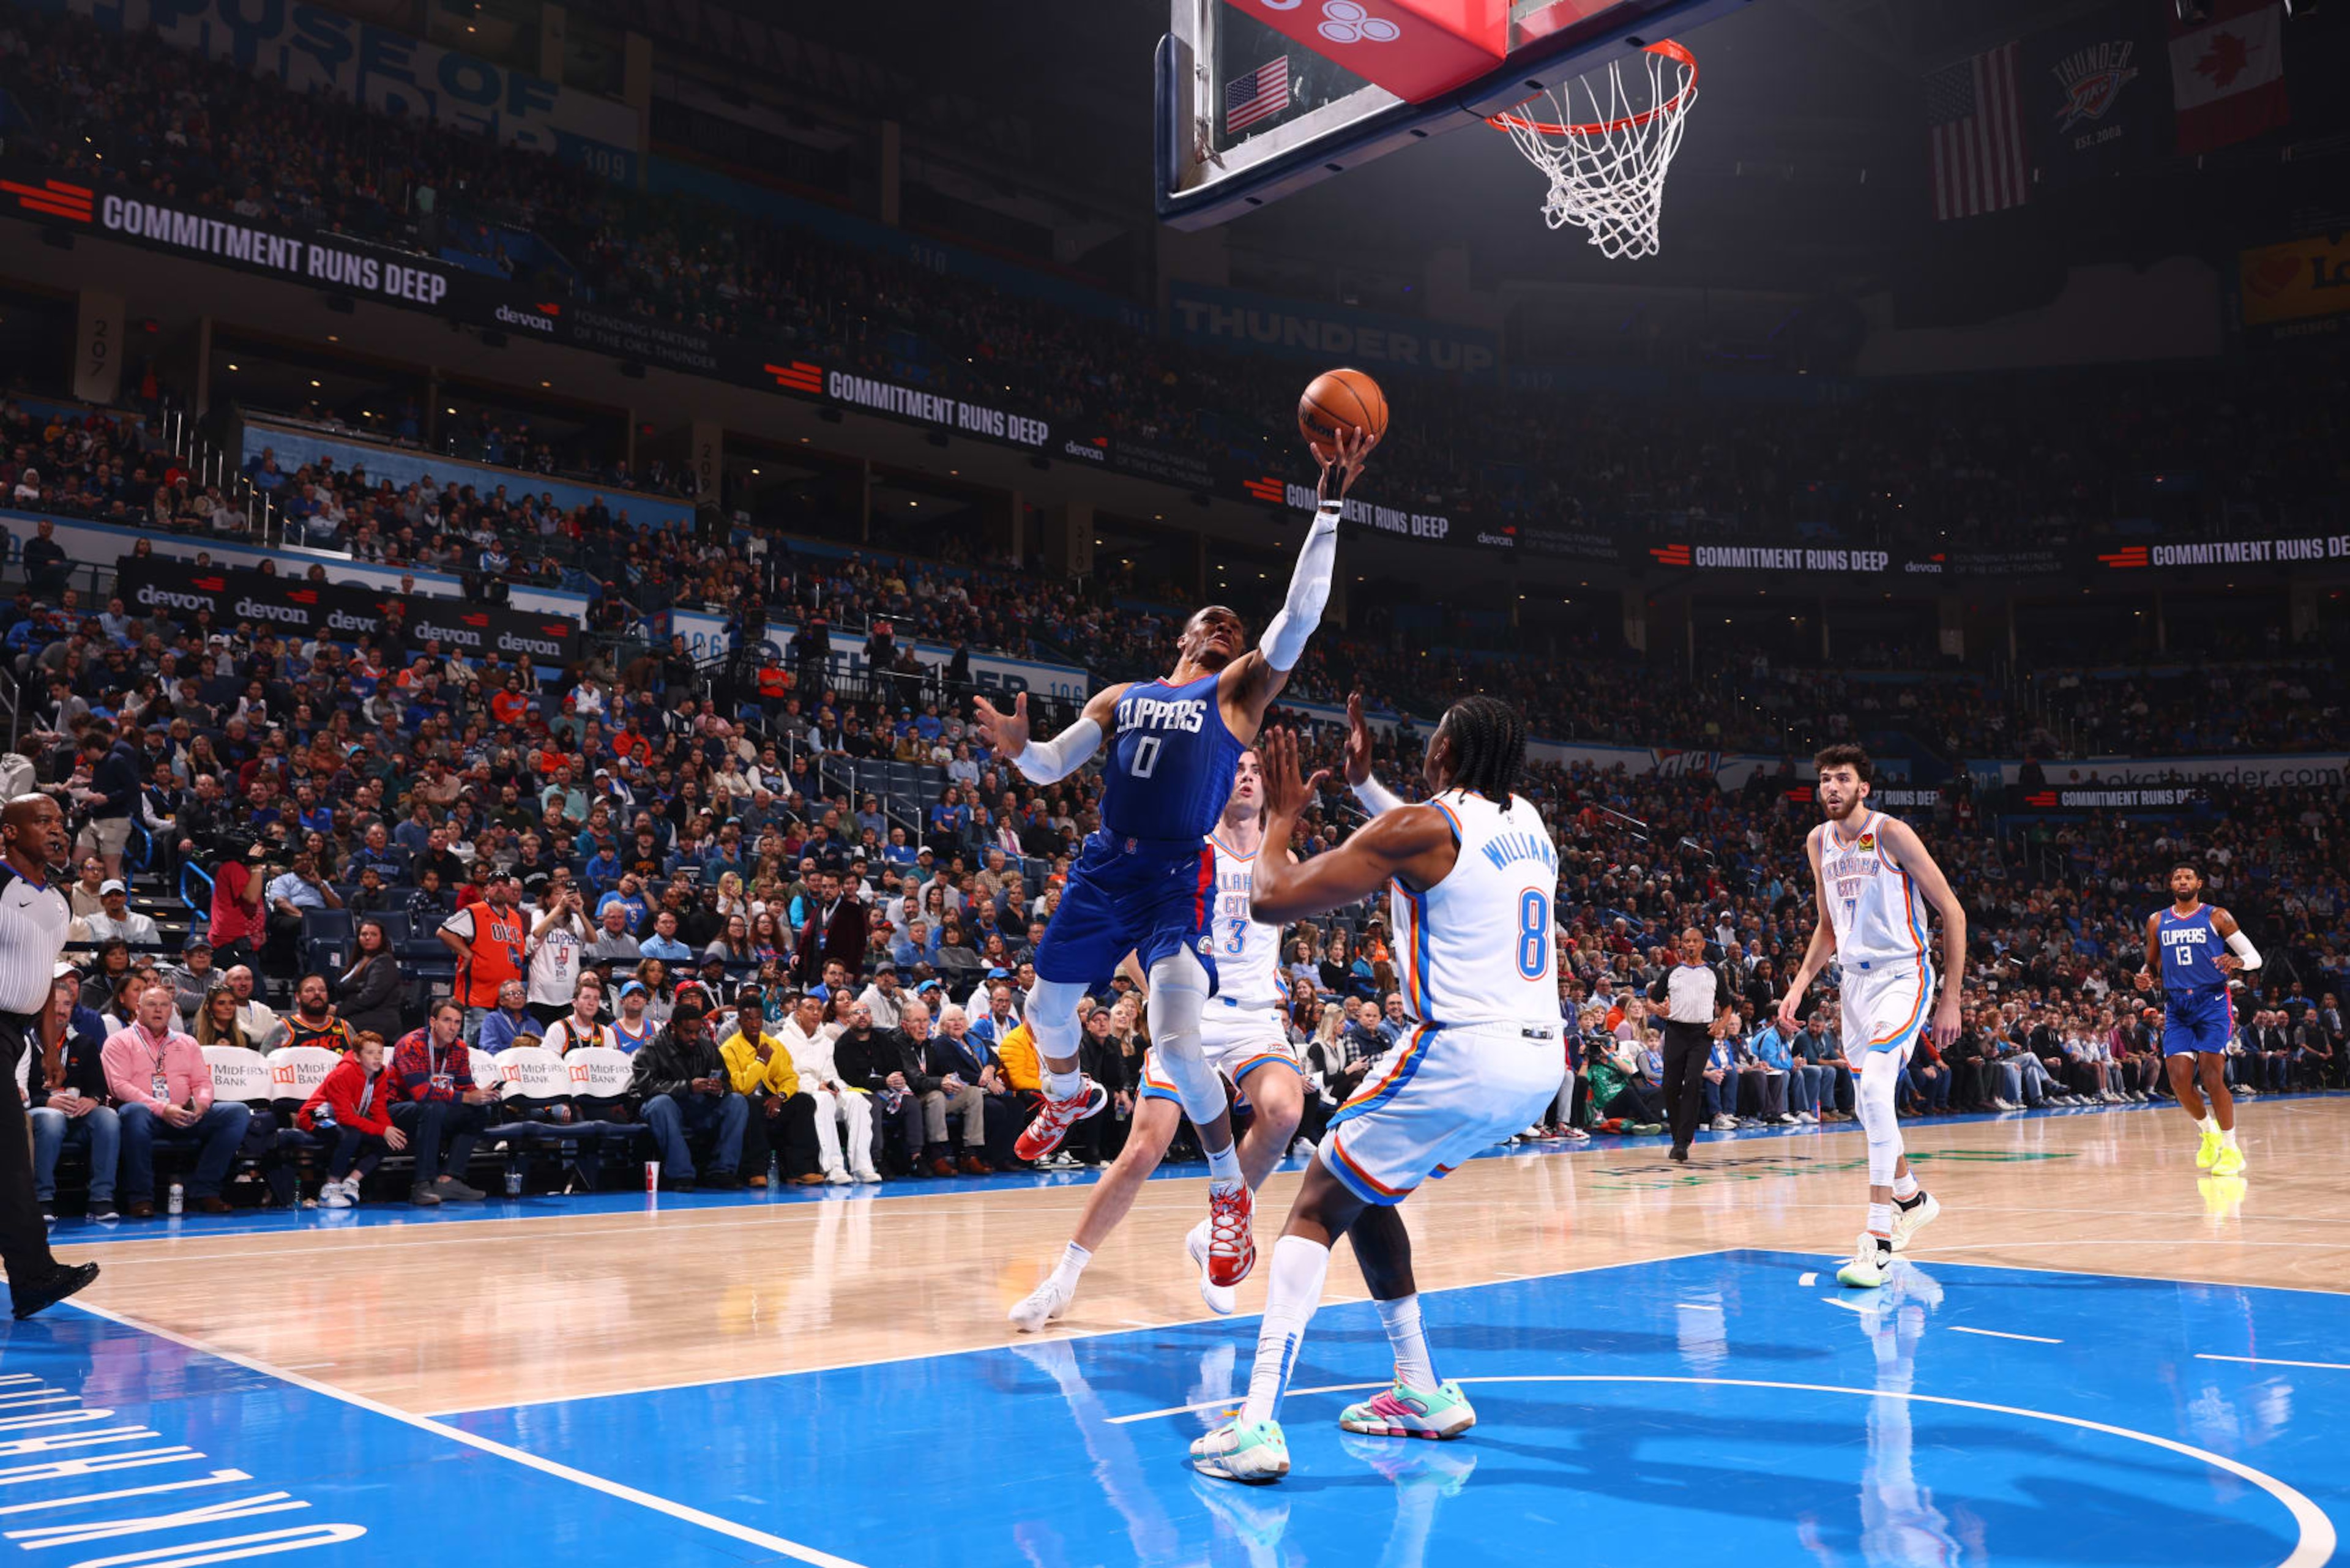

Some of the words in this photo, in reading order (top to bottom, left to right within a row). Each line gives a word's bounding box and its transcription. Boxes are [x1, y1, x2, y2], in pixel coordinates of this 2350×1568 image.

[2051, 40, 2135, 86] THUNDER
[103, 194, 303, 273] COMMITMENT
[308, 245, 379, 291] RUNS
[384, 264, 447, 305] DEEP
[495, 305, 554, 332] devon
[91, 320, 107, 376] 207
[1177, 299, 1420, 365] THUNDER
[1430, 338, 1494, 375] UP
[829, 370, 955, 426] COMMITMENT
[958, 403, 1004, 441] RUNS
[1008, 414, 1048, 447] DEEP
[1065, 440, 1104, 461] devon
[1286, 483, 1373, 526] COMMENT
[1375, 506, 1408, 534] RUNS
[1411, 513, 1449, 539] DEEP
[1476, 531, 1515, 548] devon
[2152, 540, 2272, 567] COMMITMENT
[2275, 538, 2325, 561] RUNS
[1695, 545, 1803, 570] COMMITMENT
[1806, 549, 1848, 571] RUNS
[1850, 550, 1889, 572] DEEP
[1904, 559, 1942, 573] devon
[137, 584, 219, 614] devon
[234, 597, 309, 625] devon
[414, 621, 481, 646] devon
[498, 630, 561, 657] devon
[1116, 698, 1207, 734] CLIPPERS
[1131, 736, 1162, 778] 0
[1885, 790, 1915, 806] RUNS
[2061, 790, 2139, 807] COMMITMENT
[2141, 790, 2175, 805] RUNS
[1481, 832, 1558, 876] WILLIAMS
[1845, 898, 1858, 931] 7
[1224, 916, 1250, 956] 3
[1516, 886, 1550, 982] 8
[2161, 927, 2207, 946] CLIPPERS
[2175, 946, 2193, 966] 13
[214, 1075, 247, 1087] BANK
[298, 1075, 324, 1085] BAN
[523, 1075, 550, 1085] BANK
[591, 1075, 617, 1085] BANK
